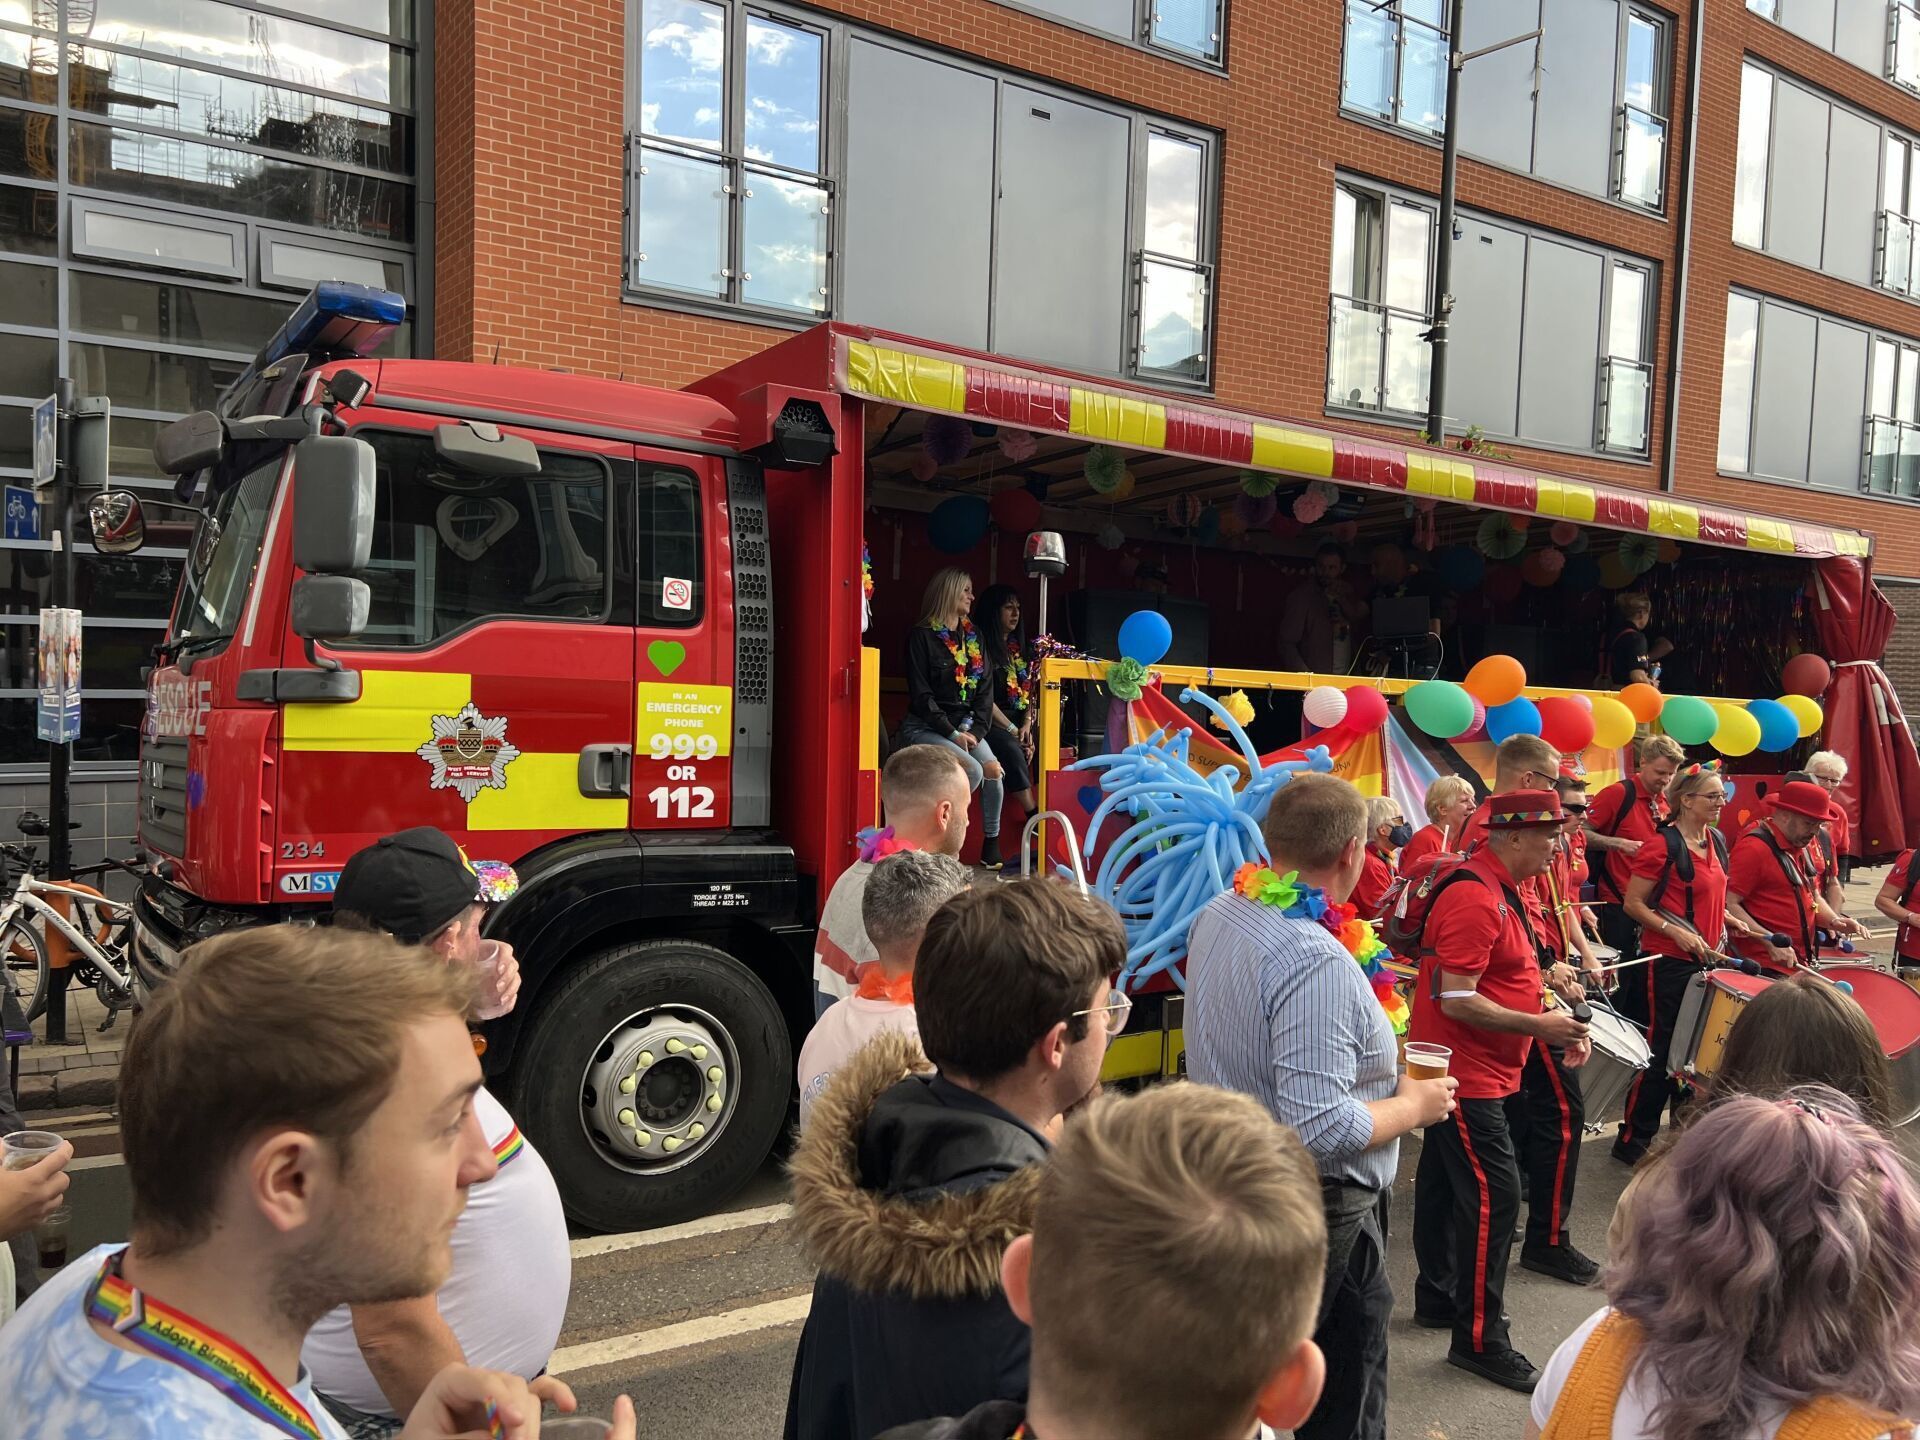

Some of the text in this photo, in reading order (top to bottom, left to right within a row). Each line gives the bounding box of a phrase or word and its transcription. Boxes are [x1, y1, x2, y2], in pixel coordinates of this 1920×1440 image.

[672, 692, 698, 701] IN AN
[646, 702, 723, 715] EMERGENCY
[664, 718, 704, 728] PHONE
[649, 733, 718, 761] 999
[666, 765, 697, 780] OR
[648, 786, 715, 819] 112
[281, 841, 325, 859] 234
[149, 1320, 196, 1350] Adopt
[198, 1343, 262, 1399] Birmingham
